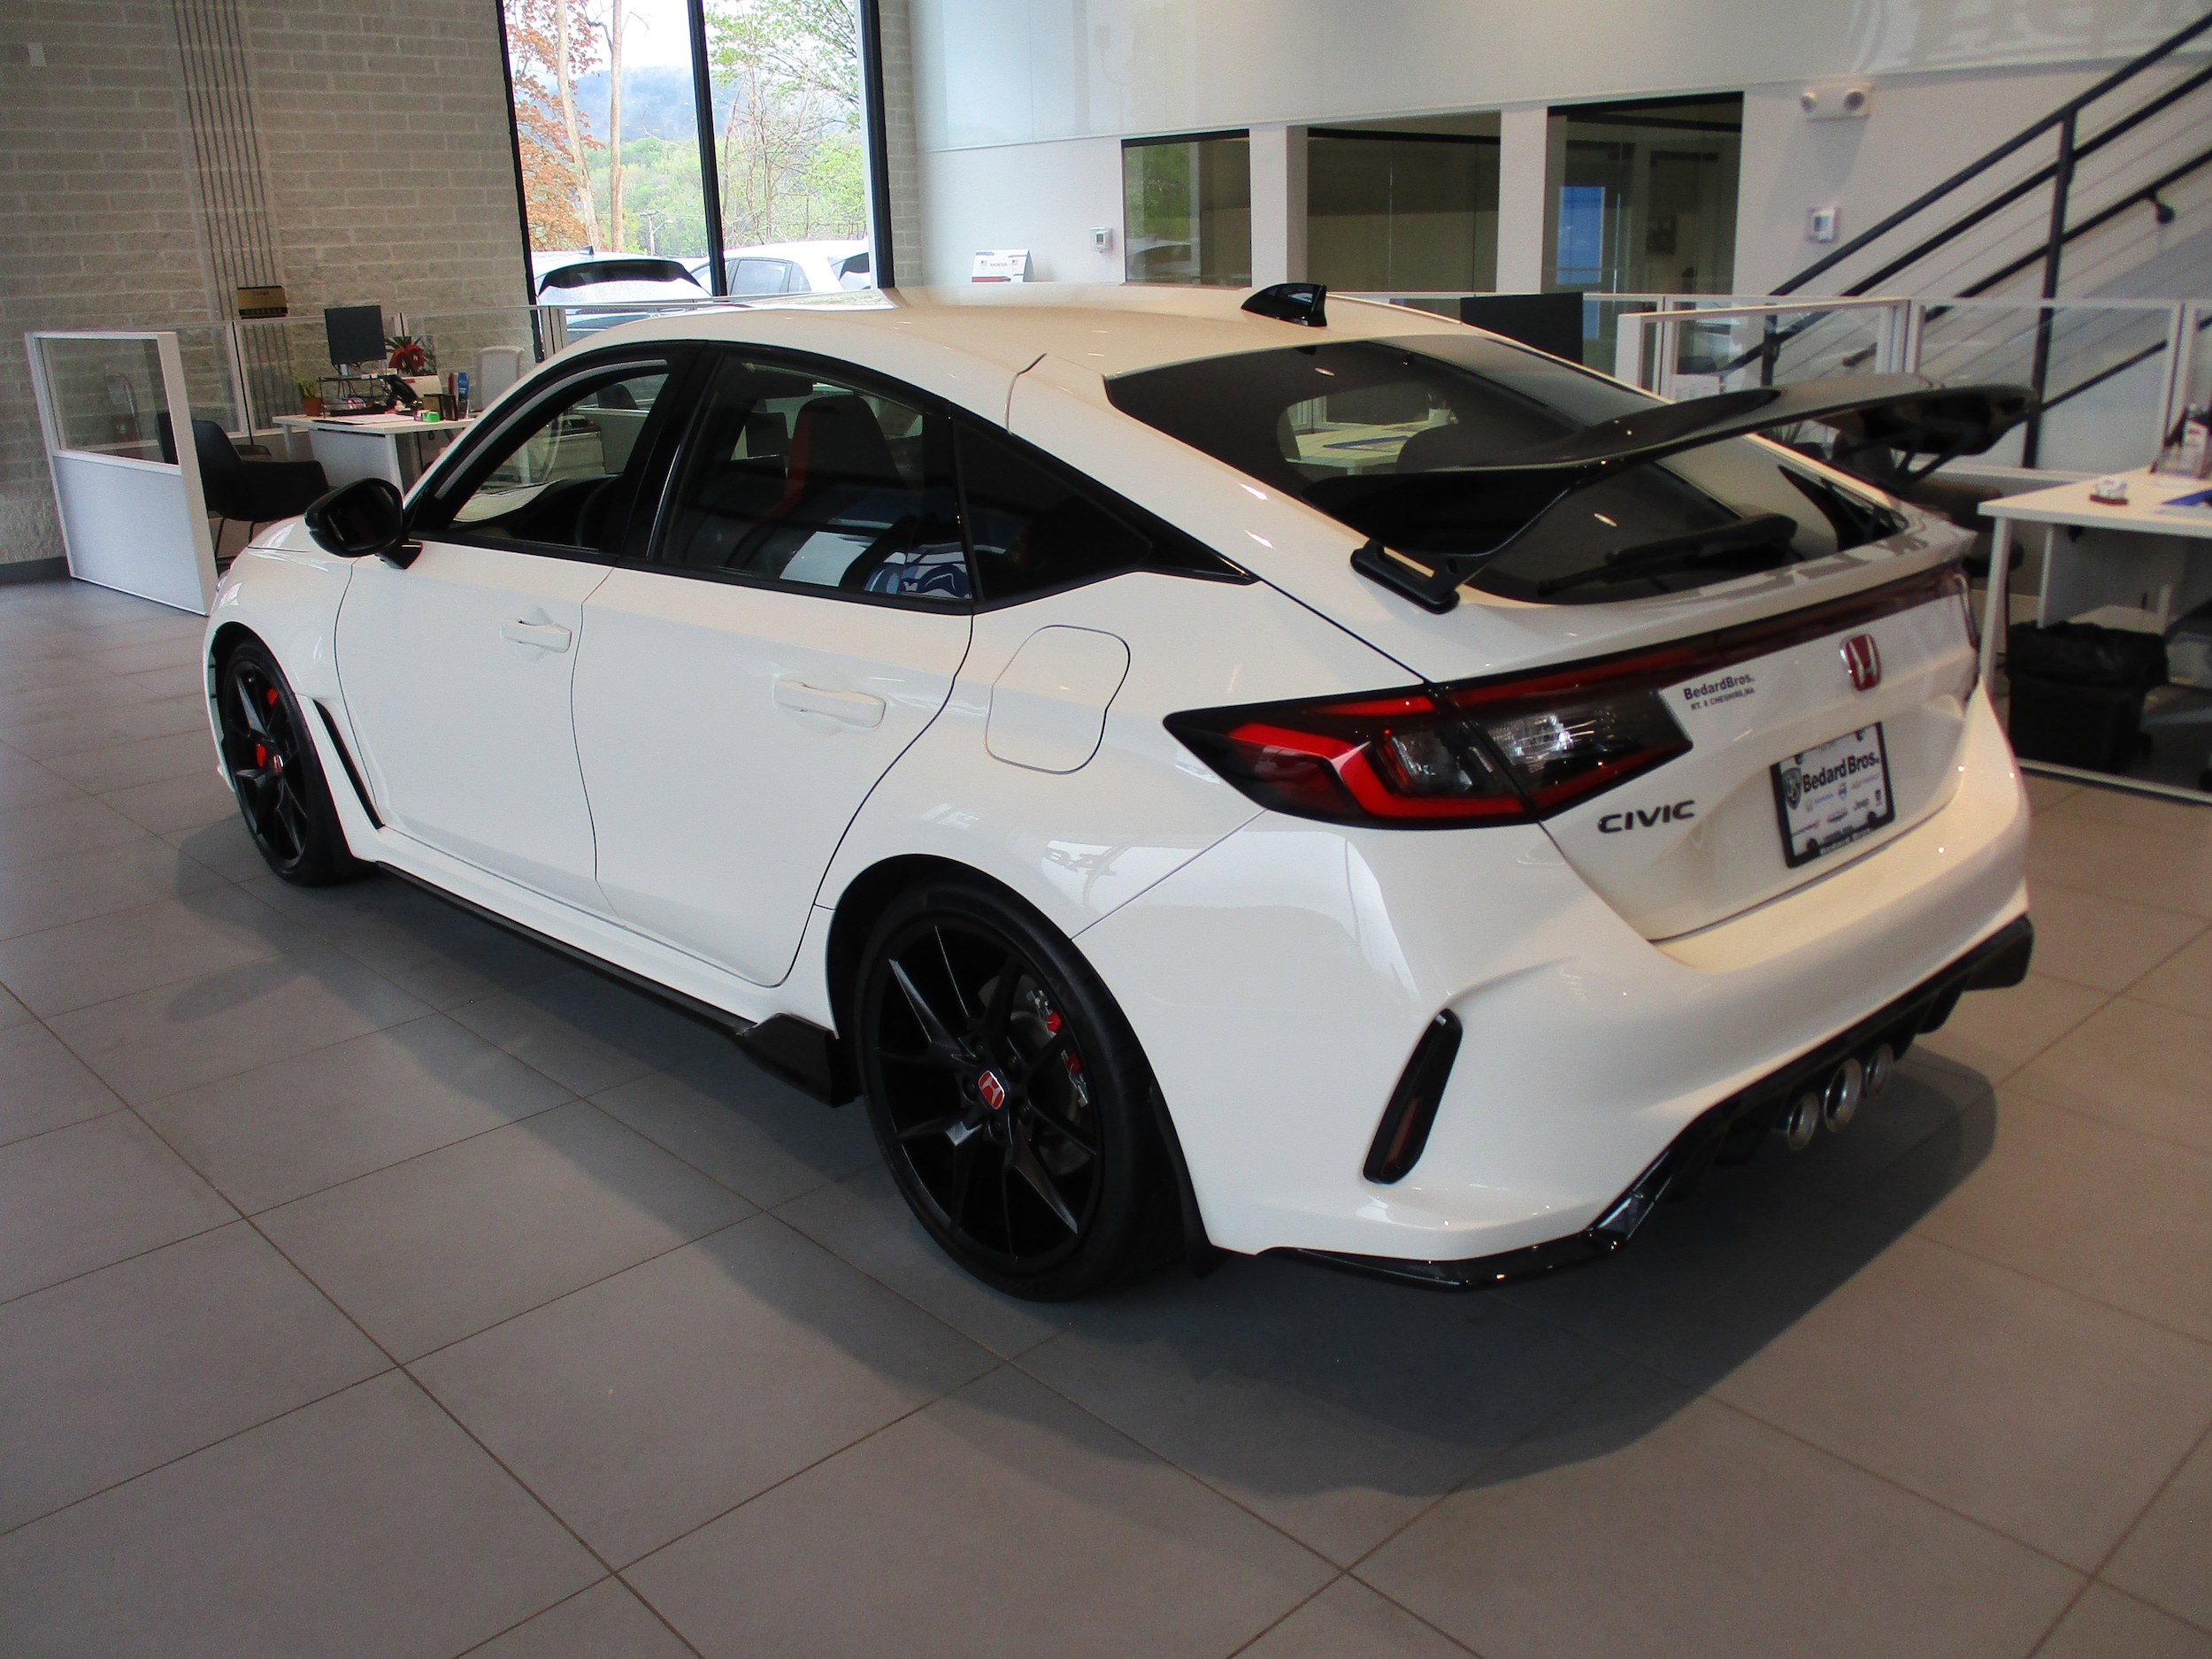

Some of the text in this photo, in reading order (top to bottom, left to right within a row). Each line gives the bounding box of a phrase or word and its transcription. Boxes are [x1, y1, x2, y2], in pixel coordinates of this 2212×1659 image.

[1802, 752, 1880, 794] Bedard Bros.
[1598, 800, 1695, 833] CIVIC
